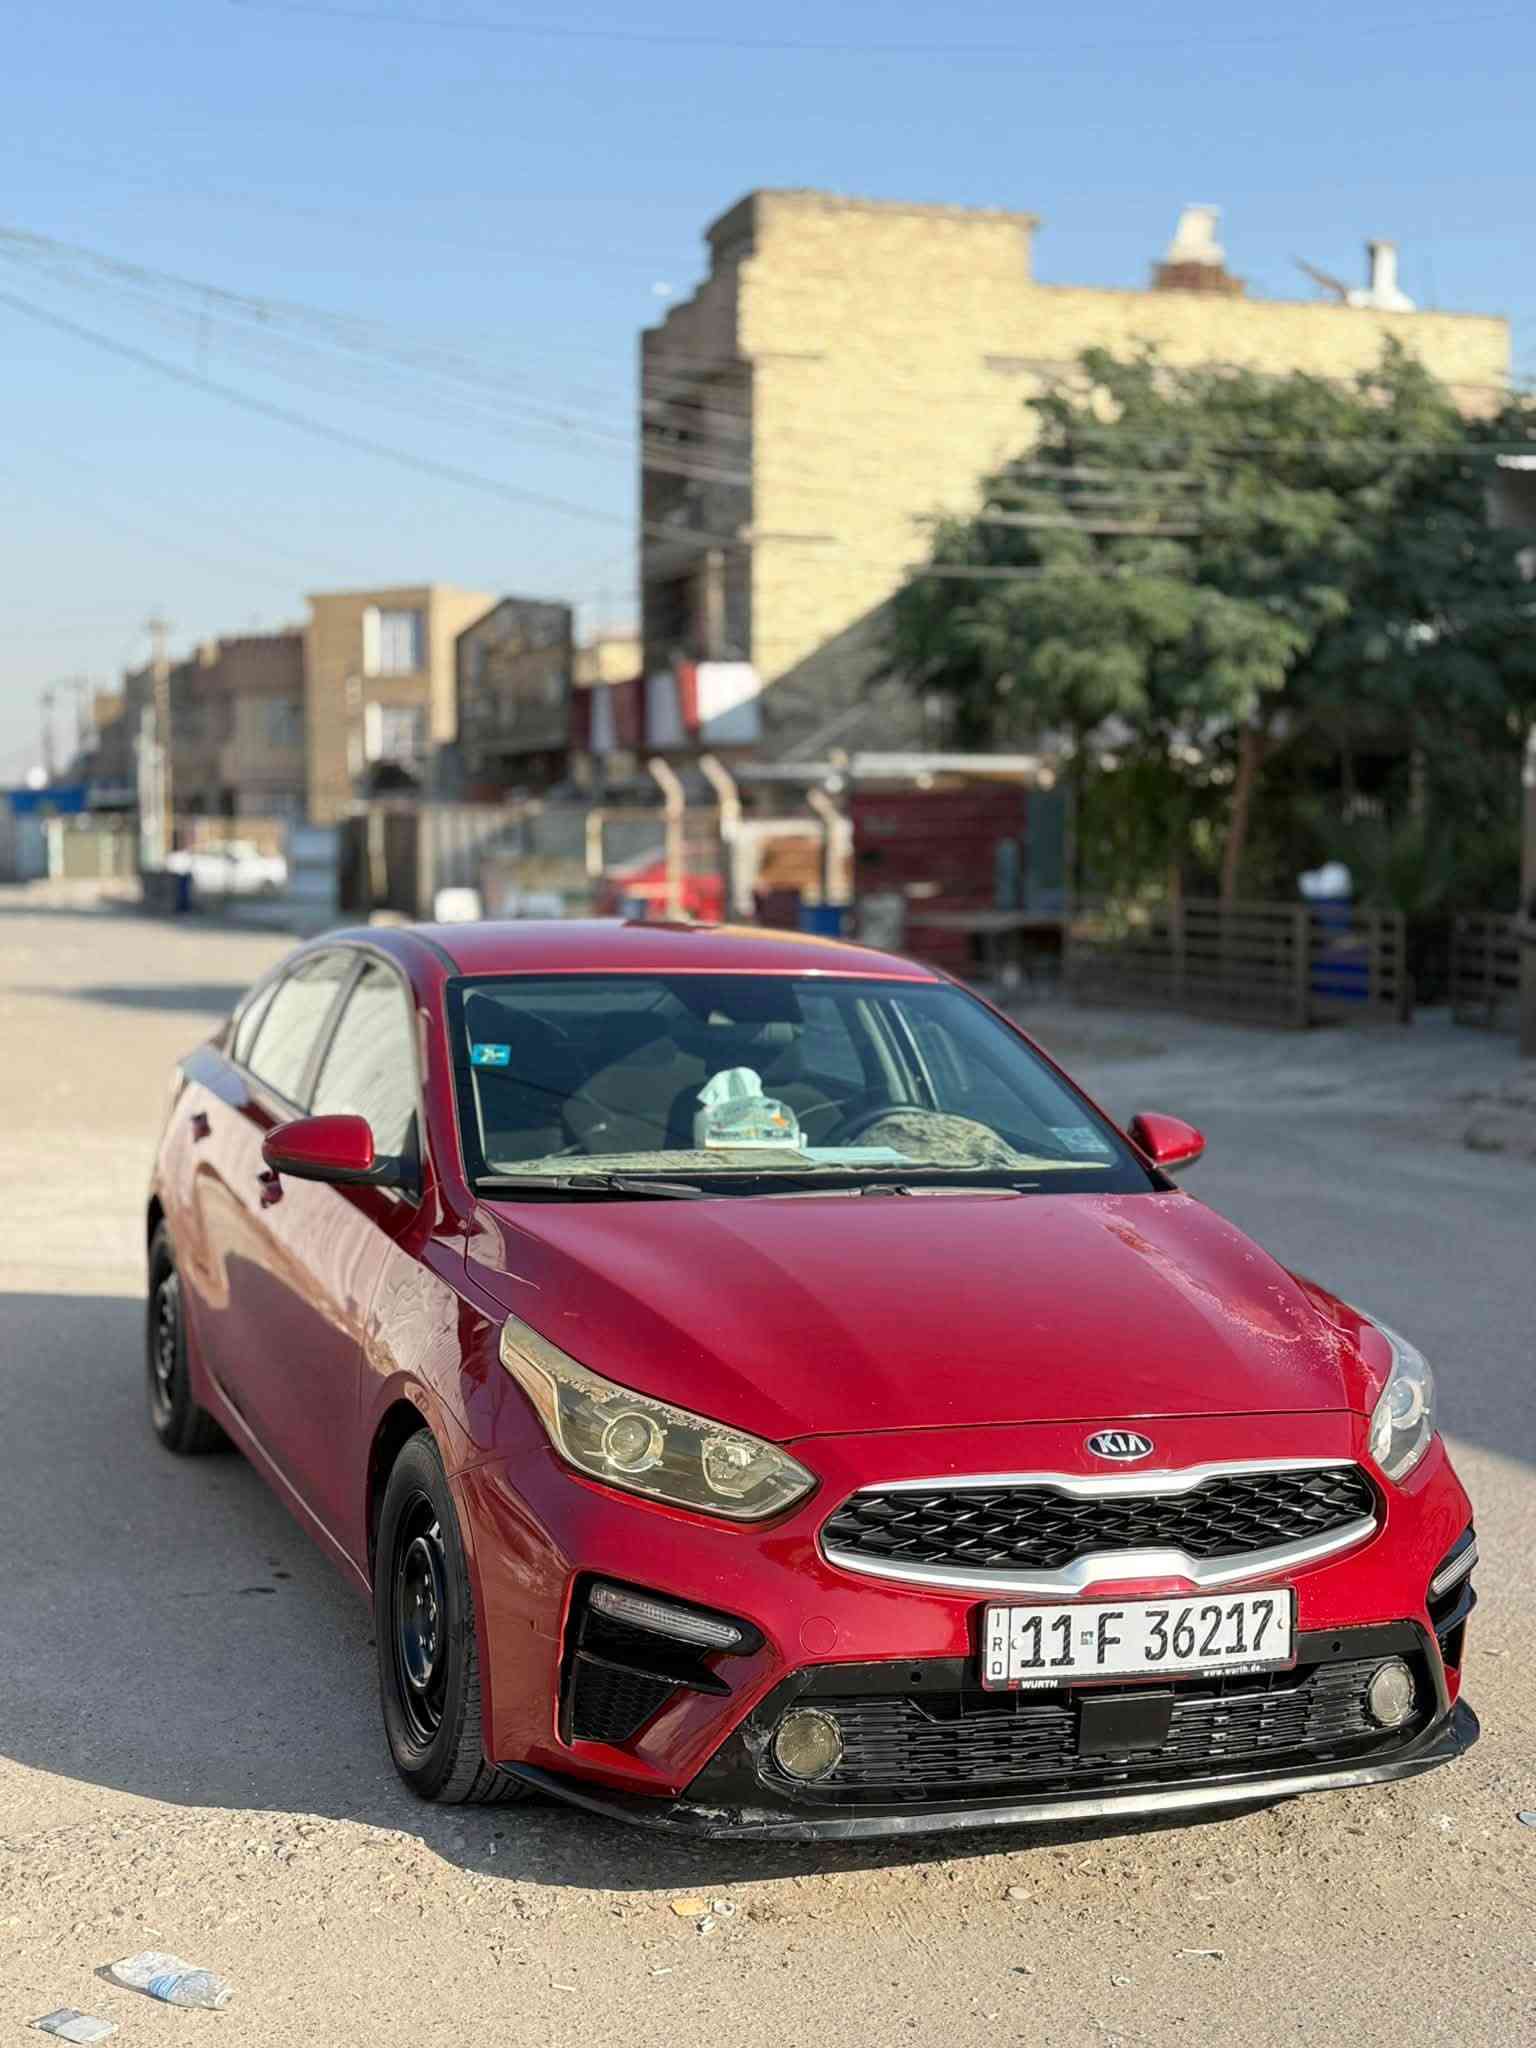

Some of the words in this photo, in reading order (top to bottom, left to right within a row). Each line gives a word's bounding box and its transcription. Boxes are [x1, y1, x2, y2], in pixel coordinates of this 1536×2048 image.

[1095, 1434, 1147, 1453] KIA
[1020, 1615, 1076, 1668] 11
[1096, 1611, 1124, 1665] F
[1144, 1599, 1274, 1661] 36217
